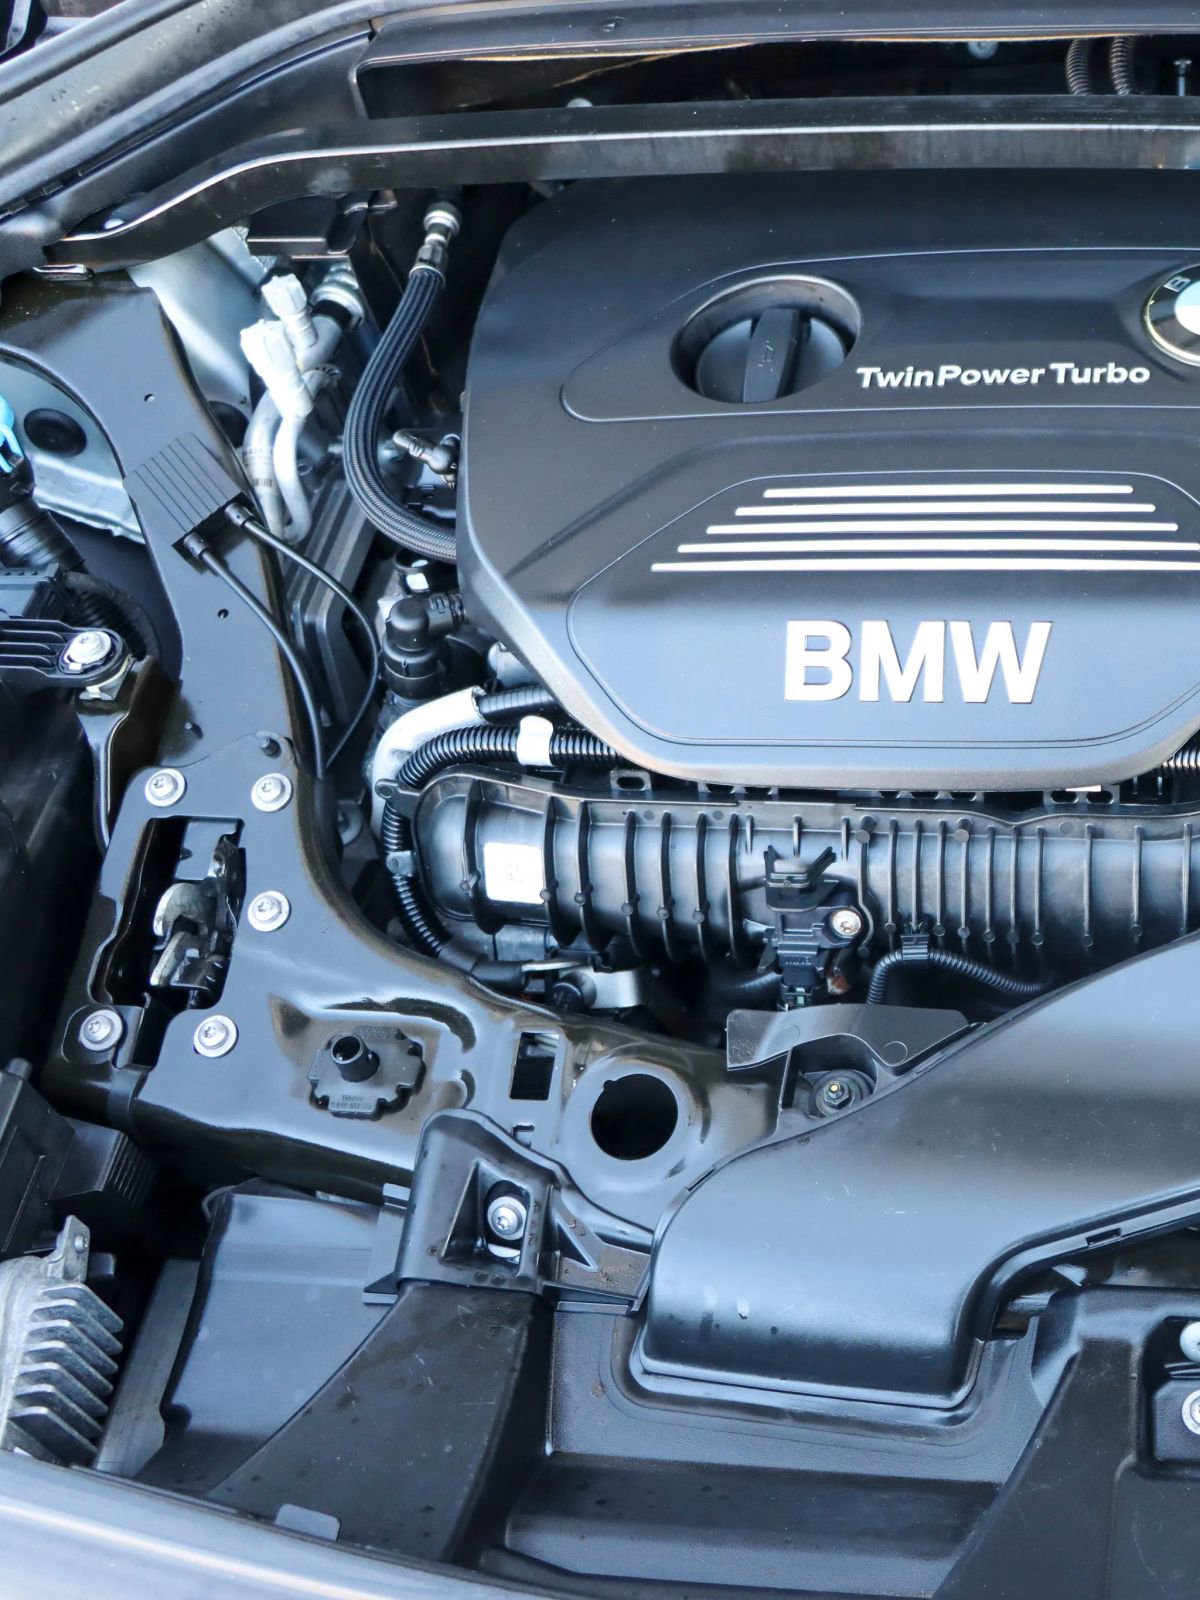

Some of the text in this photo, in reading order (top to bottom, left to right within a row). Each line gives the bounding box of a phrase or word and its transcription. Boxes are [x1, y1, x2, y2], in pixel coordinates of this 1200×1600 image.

[856, 362, 1152, 389] TwinPower Turbo
[784, 619, 1053, 704] BMW
